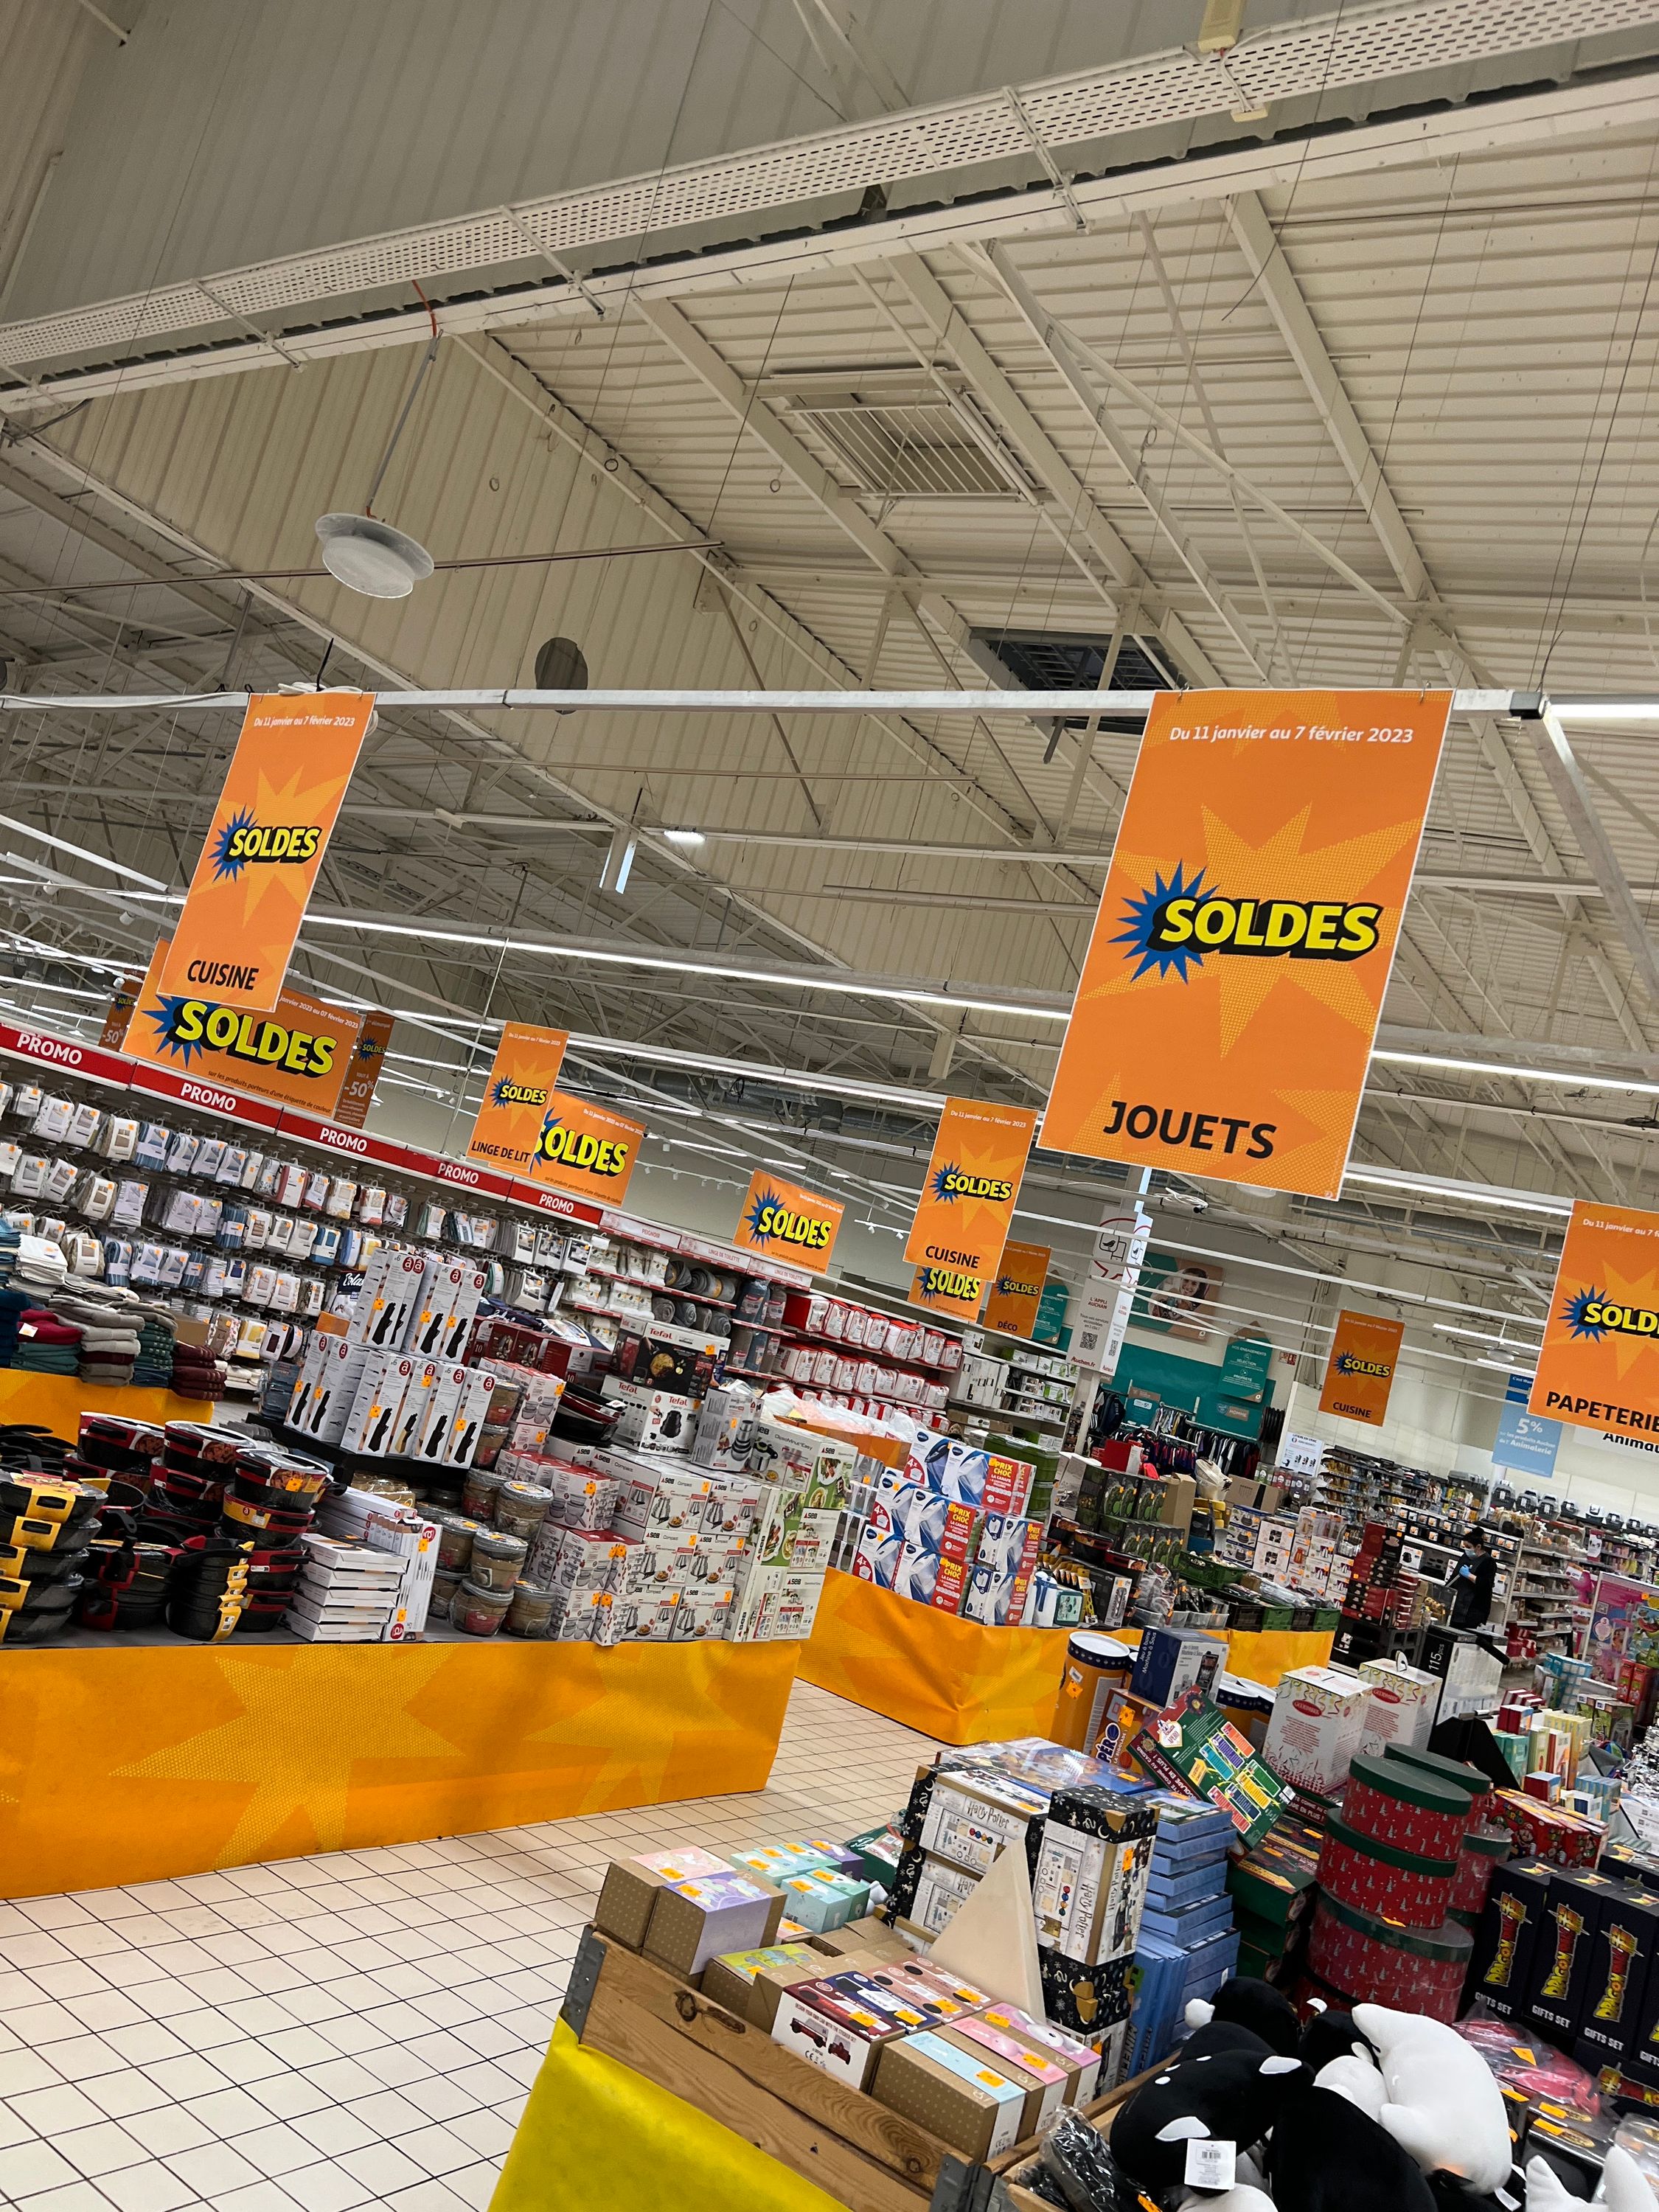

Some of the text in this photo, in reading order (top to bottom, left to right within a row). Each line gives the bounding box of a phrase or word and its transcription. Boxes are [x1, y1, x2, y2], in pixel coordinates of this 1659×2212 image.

[254, 717, 262, 726] Du
[263, 717, 270, 726] 11
[270, 717, 293, 728] janvier
[303, 716, 308, 725] 7
[310, 715, 333, 726] février
[333, 717, 355, 726] 2023
[1170, 725, 1413, 743] Du 11 janvier au 7 février 2023
[229, 826, 321, 860] SOLDES
[1160, 899, 1378, 953] SOLDES
[187, 960, 259, 990] CUISINE
[299, 1003, 313, 1012] 2023
[175, 1001, 338, 1074] SOLDES
[16, 1034, 82, 1066] PROMO
[362, 1043, 386, 1054] SOLDES
[181, 1082, 237, 1113] PROMO
[500, 1085, 547, 1105] SOLDES
[964, 1113, 982, 1121] janvier
[995, 1117, 1012, 1125] février
[1102, 1099, 1277, 1159] JOUETS
[319, 1127, 368, 1154] PROMO
[471, 1141, 531, 1163] LINGE DE LIT
[437, 1163, 479, 1185] PROMO
[944, 1174, 1012, 1200] SOLDES
[539, 1193, 574, 1214] PROMO
[759, 1206, 832, 1248] SOLDES
[1582, 1218, 1595, 1226] Du
[1595, 1220, 1605, 1228] 11
[1605, 1222, 1634, 1234] janvier
[925, 1245, 980, 1269] CUISINE
[927, 1268, 980, 1299] SOLDES
[1003, 1281, 1040, 1295] SOLDES
[998, 1320, 1018, 1332] DÉCO
[1584, 1302, 1659, 1335] SOLD
[650, 1328, 672, 1340] Tefal
[474, 1344, 482, 1354] 10
[1071, 1356, 1096, 1367] Auchan.fr
[1343, 1358, 1391, 1377] SOLDES
[567, 1374, 575, 1382] 10
[618, 1382, 638, 1394] Tefal
[669, 1396, 687, 1406] Tefal
[1332, 1402, 1371, 1419] CUISINE
[1516, 1418, 1543, 1434] 5%
[1510, 1439, 1552, 1455] Animalerie
[907, 1458, 918, 1467] 4x
[995, 1461, 1013, 1472] PRIX
[994, 1467, 1012, 1478] CHOC
[874, 1505, 883, 1514] 4x
[954, 1509, 971, 1519] PRIX
[953, 1514, 970, 1525] CHOC
[857, 1556, 866, 1565] 4x
[945, 1563, 962, 1573] PRIX
[944, 1568, 961, 1579] CHOC
[1142, 1651, 1152, 1674] Machine
[1156, 1757, 1169, 1770] PLUS
[1157, 1770, 1172, 1784] COMME
[1168, 1770, 1177, 1778] EN
[967, 1801, 1009, 1829] Harry Potter
[1307, 1809, 1321, 1820] PLUS
[957, 1877, 975, 1896] Harr
[1108, 1860, 1122, 1910] Harry Potter
[1076, 1884, 1095, 1938] Harry Potter
[1497, 2002, 1512, 2015] SET
[1532, 2005, 1571, 2028] GIFTS SET
[1585, 2028, 1624, 2051] GIFTS SET
